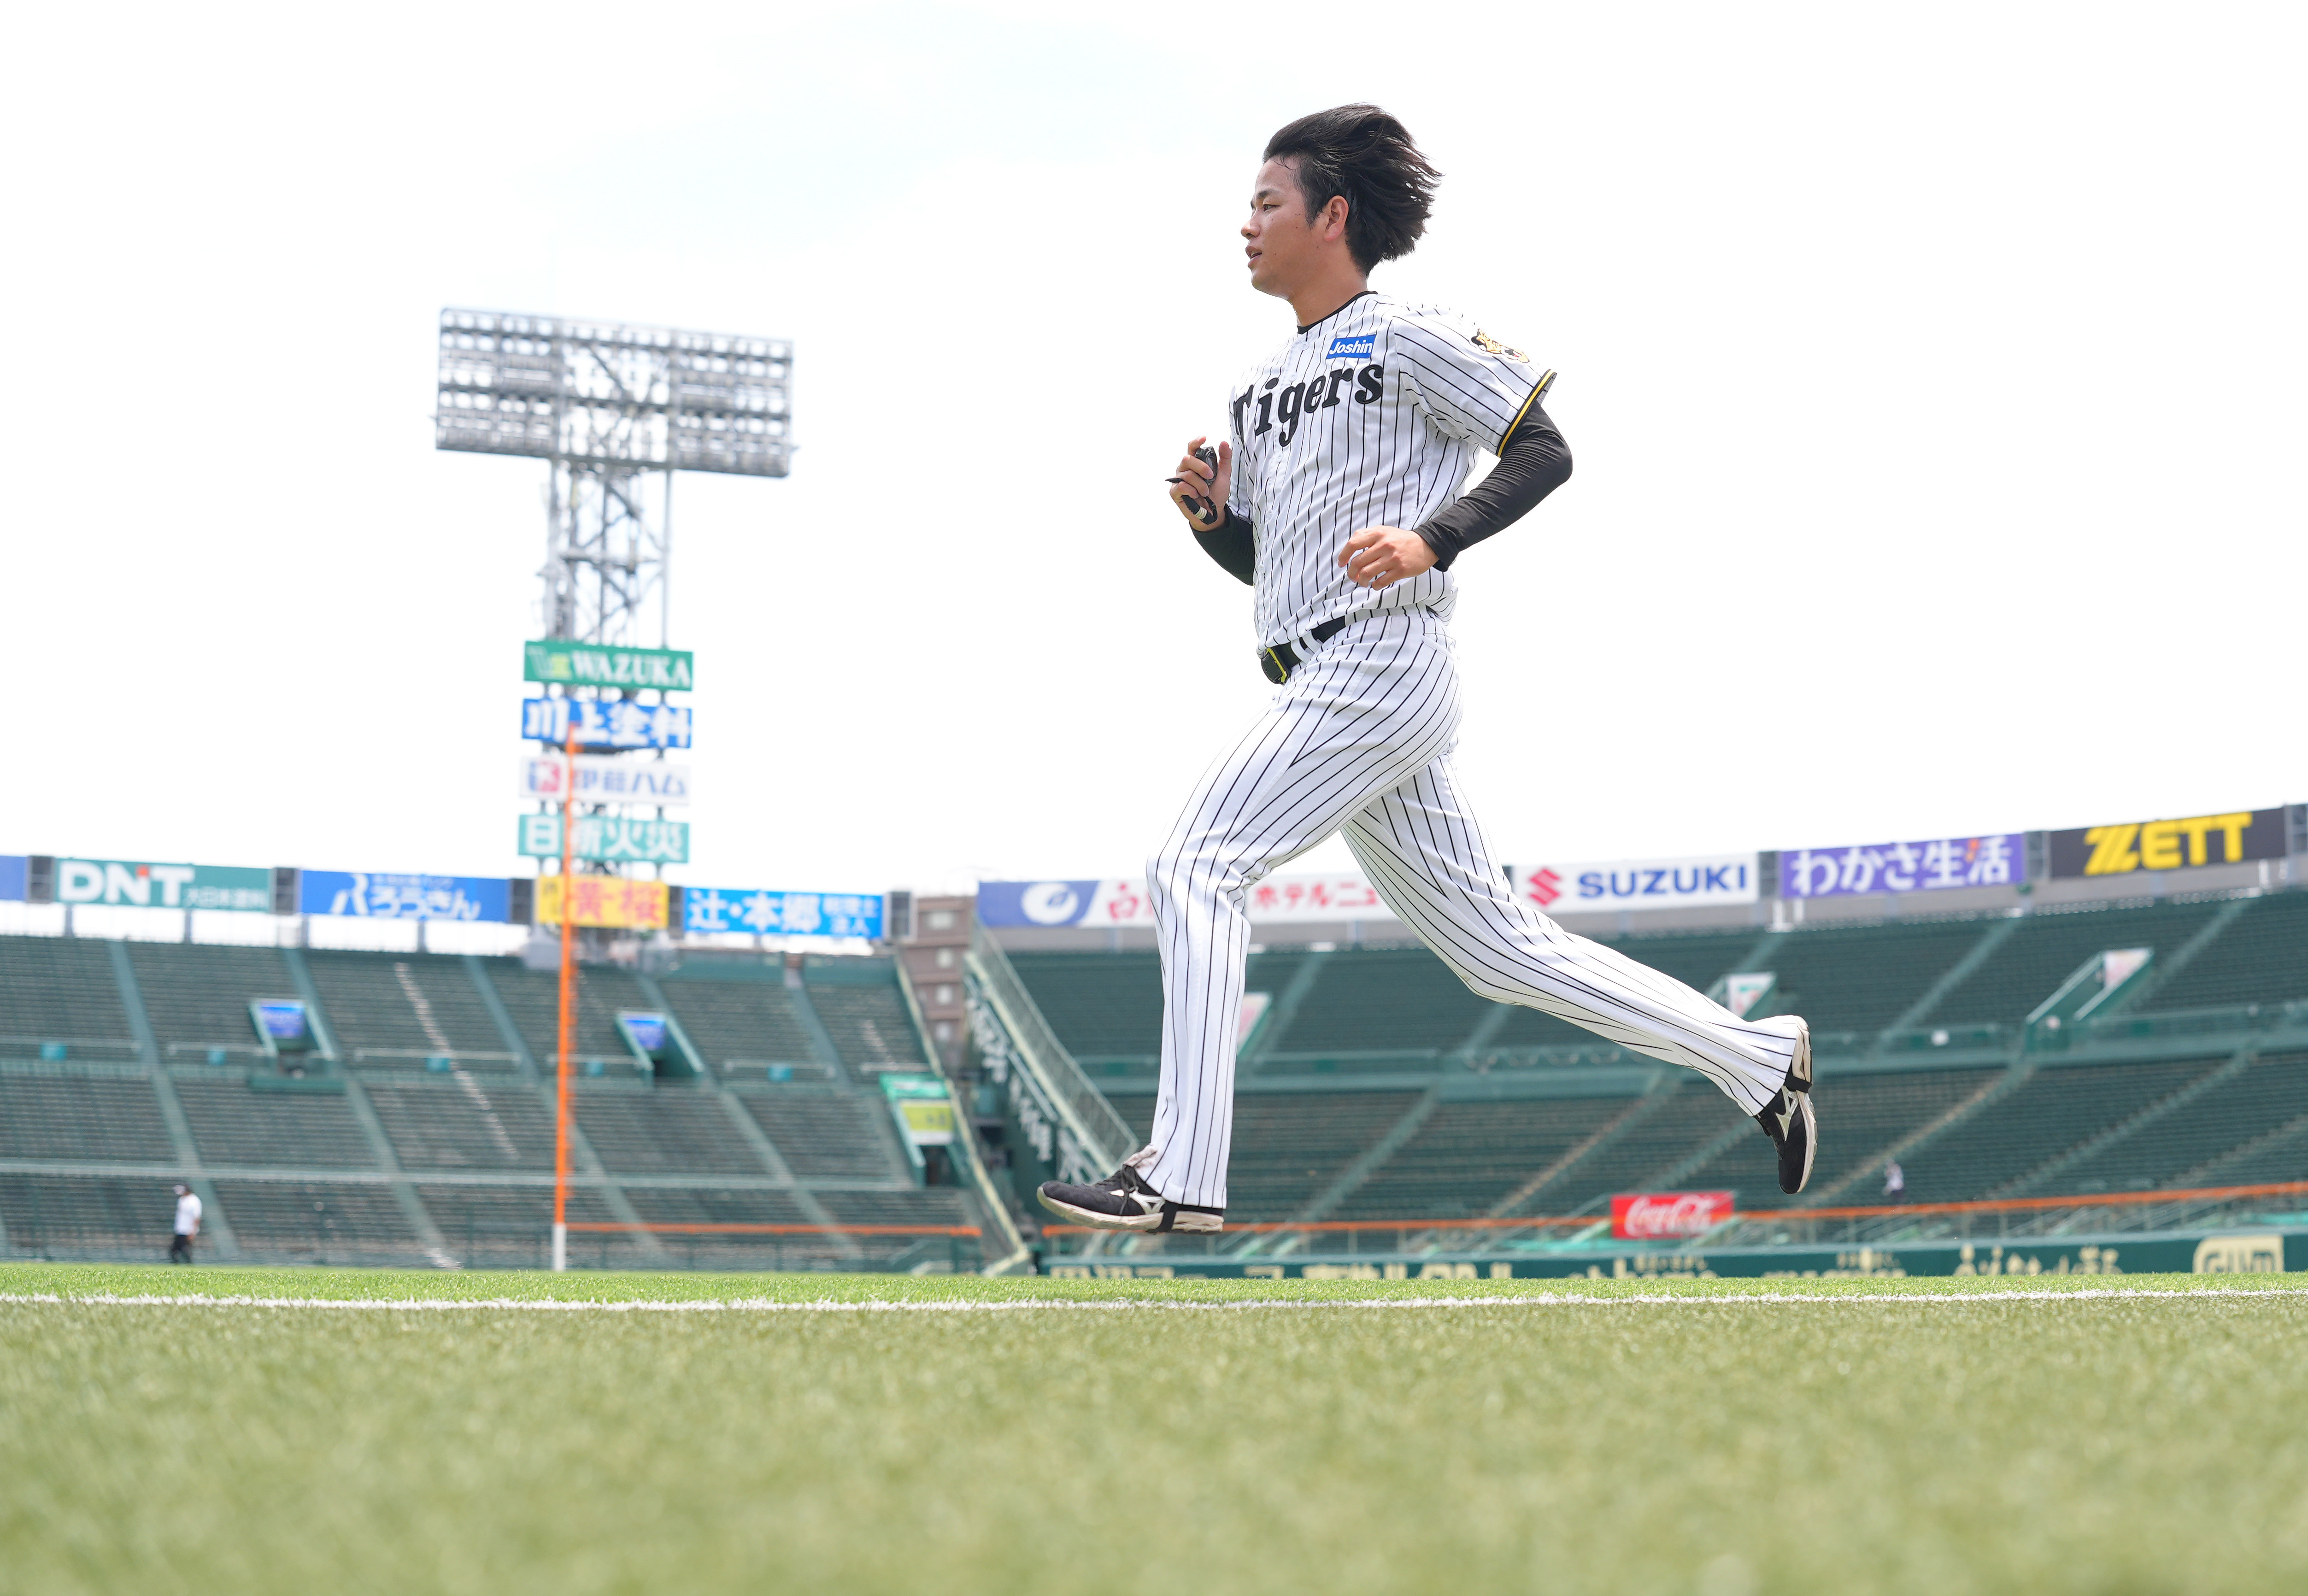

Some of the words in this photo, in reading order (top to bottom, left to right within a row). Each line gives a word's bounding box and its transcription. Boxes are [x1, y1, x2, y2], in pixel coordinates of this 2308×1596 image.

[1329, 339, 1373, 355] Joshin
[572, 650, 691, 687] WAZUKA
[2083, 811, 2253, 876] ZETT
[59, 860, 195, 906] DNT
[1578, 865, 1746, 898] SUZUKI
[1791, 836, 2012, 896] わかさ生活
